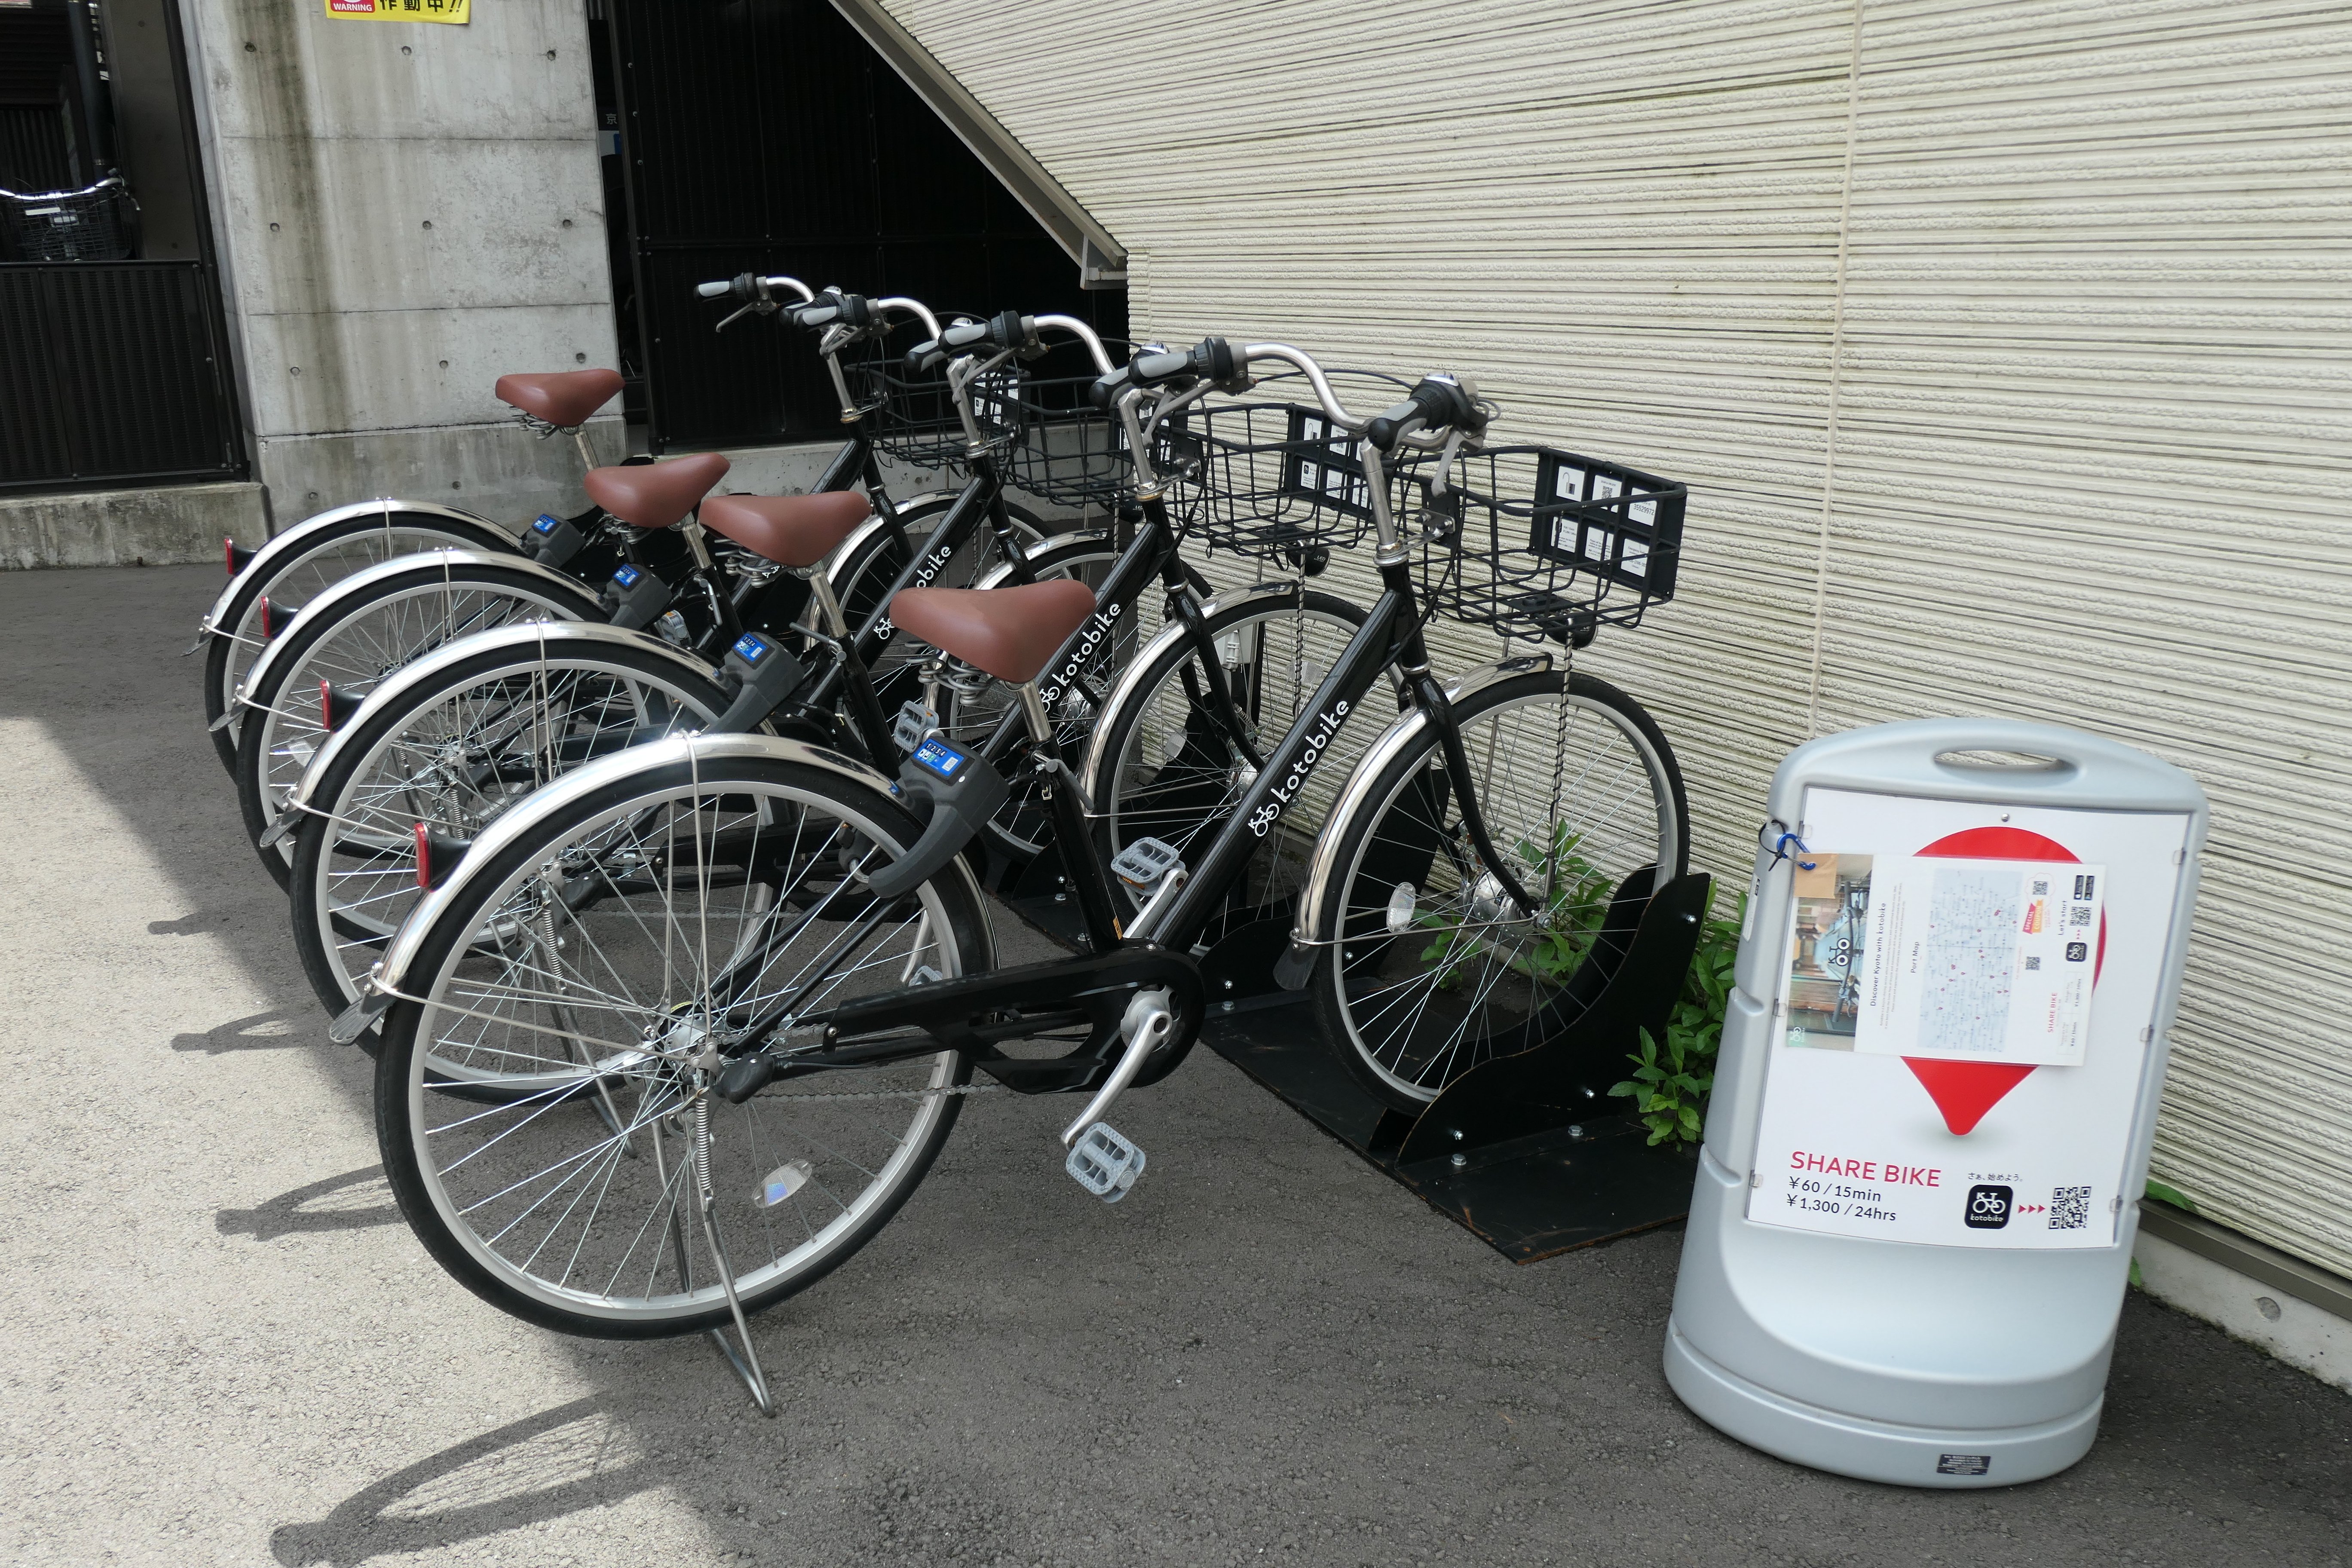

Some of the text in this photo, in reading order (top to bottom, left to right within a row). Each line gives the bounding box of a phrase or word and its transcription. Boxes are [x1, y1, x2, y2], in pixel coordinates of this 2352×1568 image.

[333, 3, 373, 12] WARNING
[605, 113, 618, 125] 京
[1633, 503, 1655, 516] 35529972
[916, 546, 952, 588] obike
[1051, 603, 1121, 687] kotobike
[1270, 700, 1349, 803] kotobike
[1876, 903, 1886, 935] kotobike
[2025, 911, 2034, 931] SPECIAL
[1912, 941, 1920, 957] Map
[1873, 954, 1881, 974] Kyoto
[1870, 976, 1879, 1007] Discover
[1790, 1151, 1942, 1187] SHARE BIKE
[1834, 1185, 1881, 1202] 15min
[1855, 1206, 1896, 1221] 24hrs
[1970, 1213, 2004, 1222] kotobike
